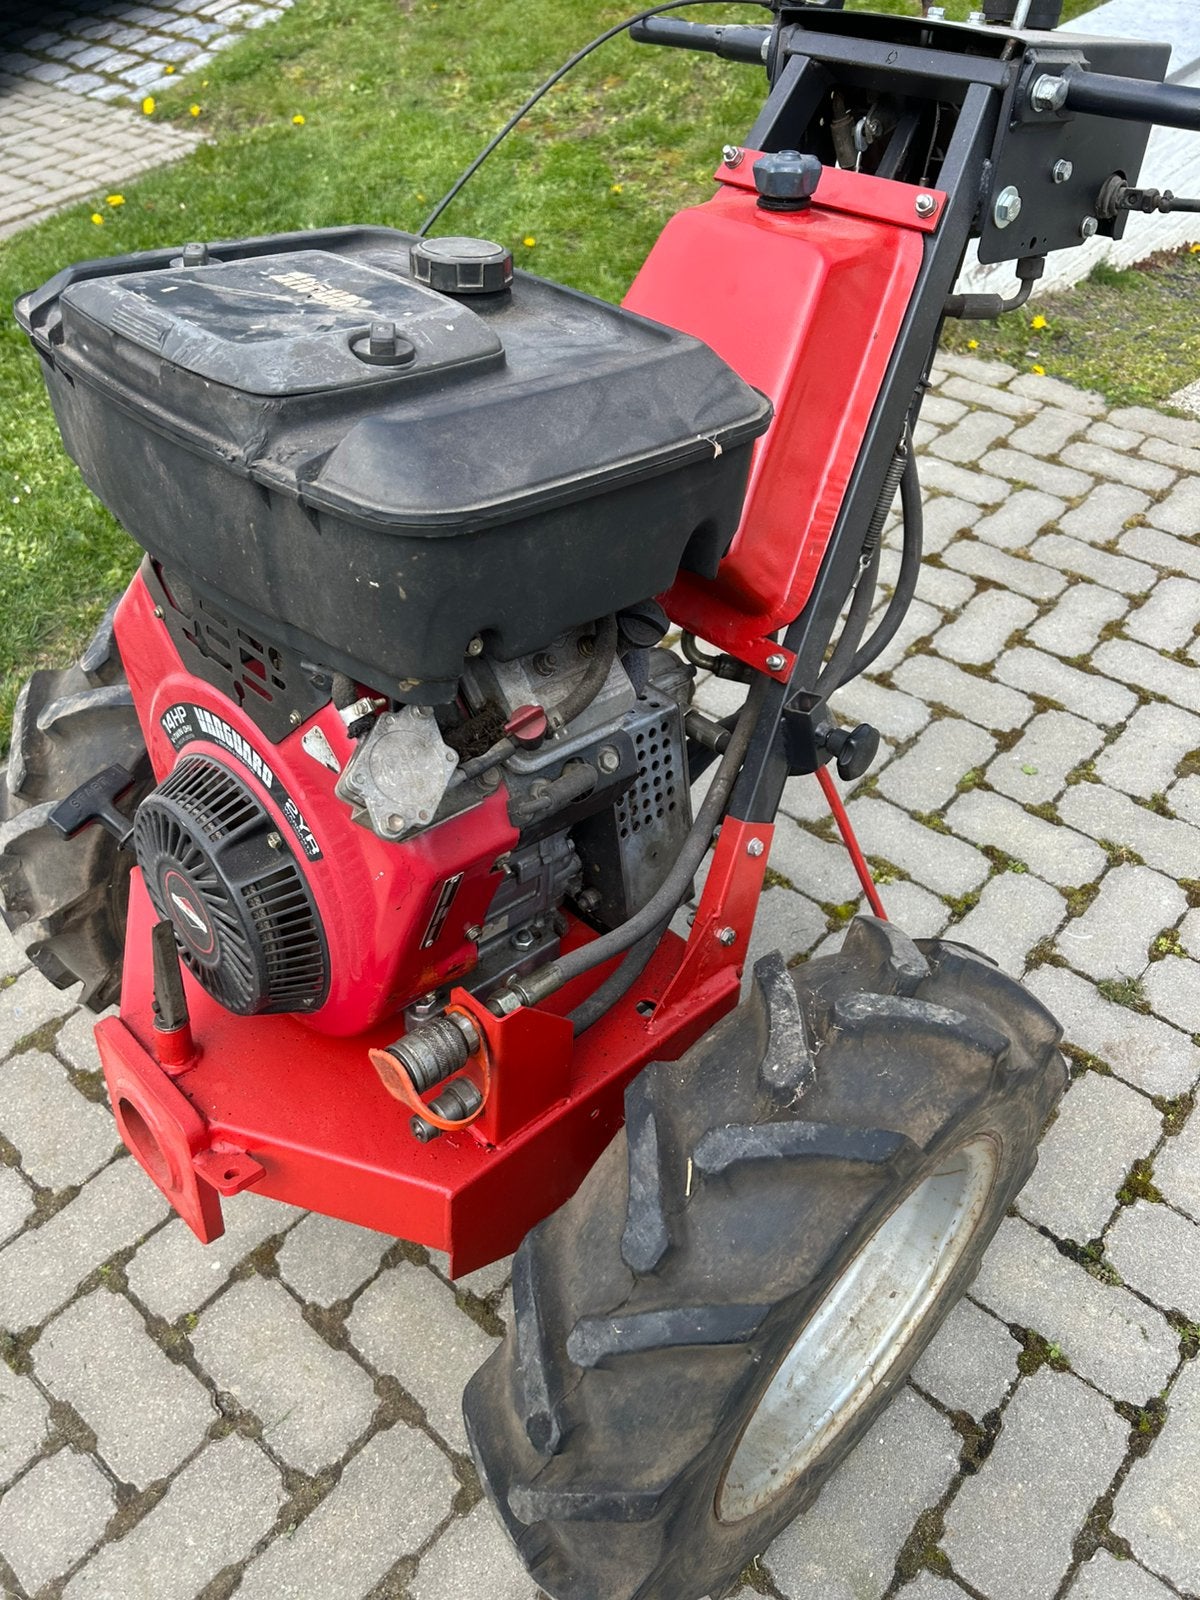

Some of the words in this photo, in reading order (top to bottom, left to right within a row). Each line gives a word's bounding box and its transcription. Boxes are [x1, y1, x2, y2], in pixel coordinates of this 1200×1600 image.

[161, 706, 187, 734] 14HP
[193, 706, 273, 789] VANGUARD
[71, 776, 108, 809] START
